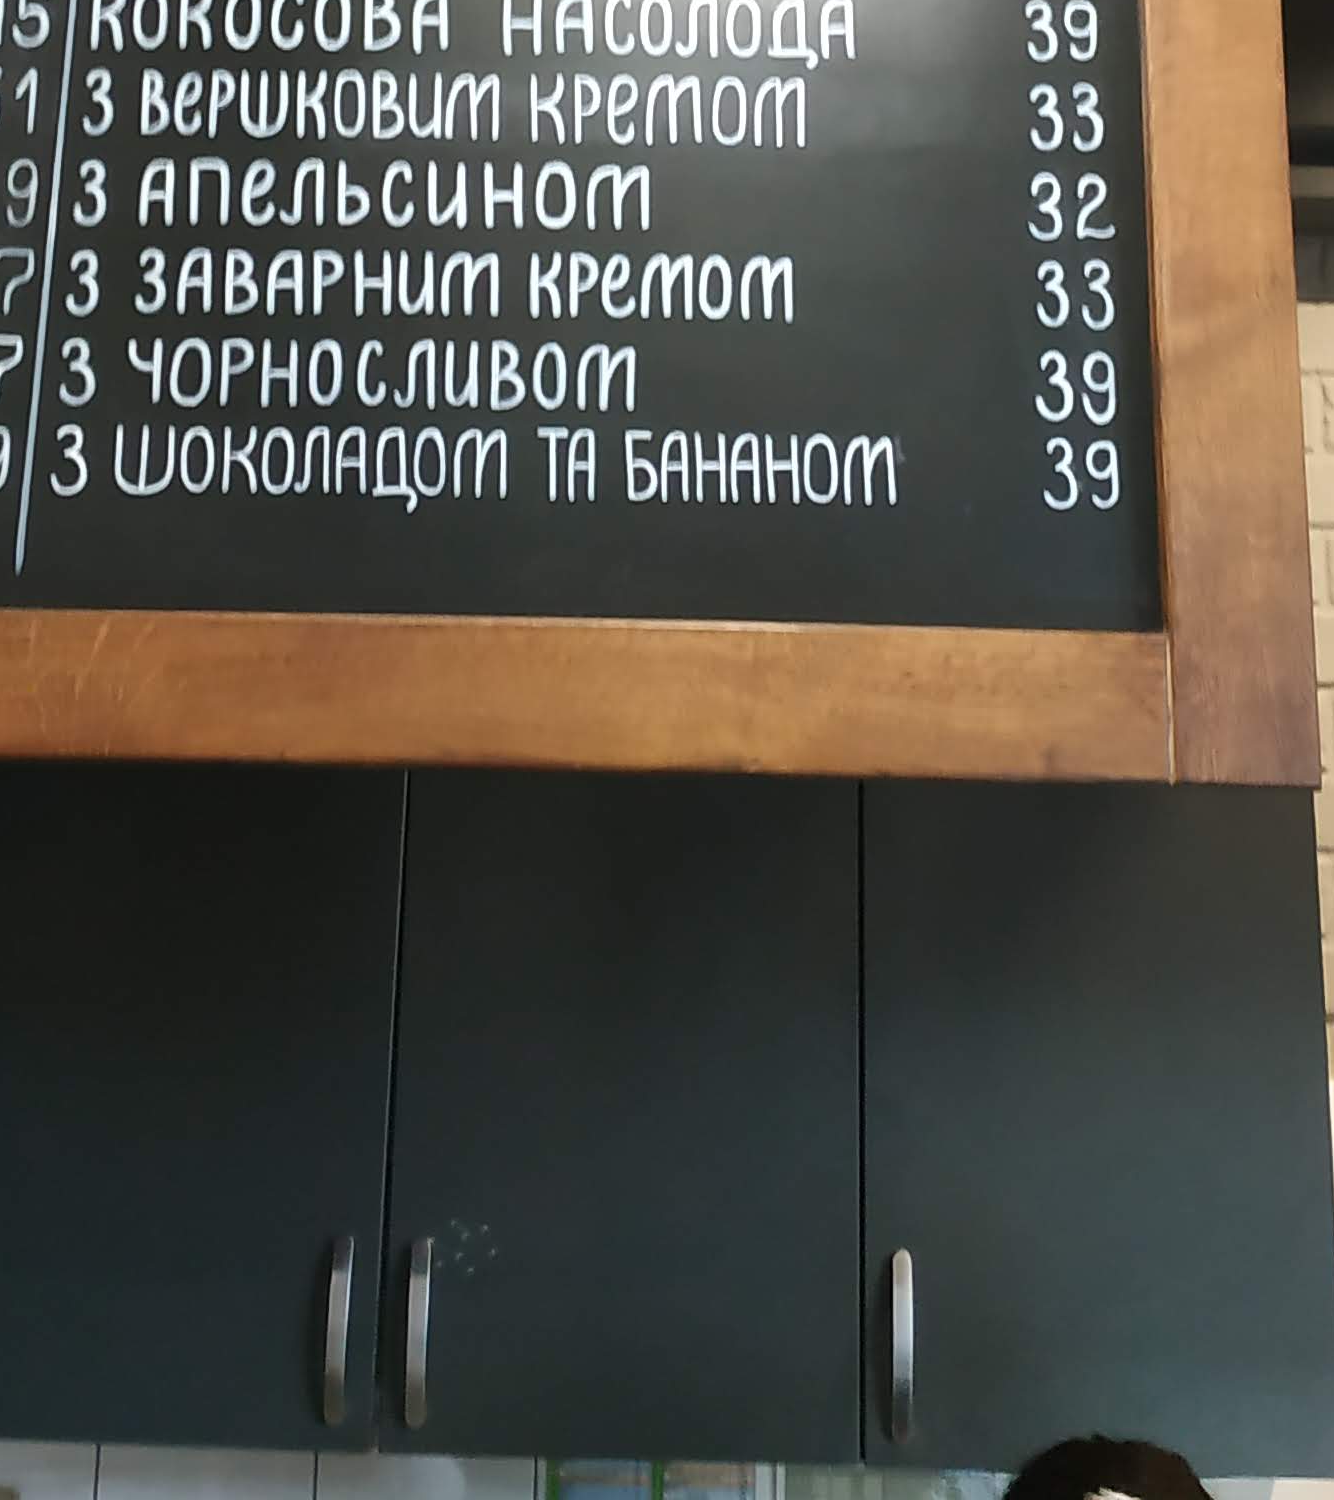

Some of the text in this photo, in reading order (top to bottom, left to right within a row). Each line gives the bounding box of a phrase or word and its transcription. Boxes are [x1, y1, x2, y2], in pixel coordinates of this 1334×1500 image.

[139, 68, 503, 142] ВЕРШКОВИМ
[529, 72, 808, 149] КРЕМОМ
[1027, 82, 1106, 154] 33
[138, 157, 652, 231] АПЕЛЬСИНОМ
[1027, 171, 1116, 242] 32
[134, 248, 501, 320] ЗАВАРНИМ
[528, 250, 795, 324] КРЕМОМ
[1036, 258, 1116, 331] 33
[127, 336, 638, 413] ЧОРНОСЛИВОМ
[1034, 349, 1118, 426] 39
[113, 422, 508, 515] ШОКОЛАДОМ
[537, 426, 596, 504] ТА
[624, 427, 898, 508] БАНАНОМ
[1042, 436, 1120, 511] 39
